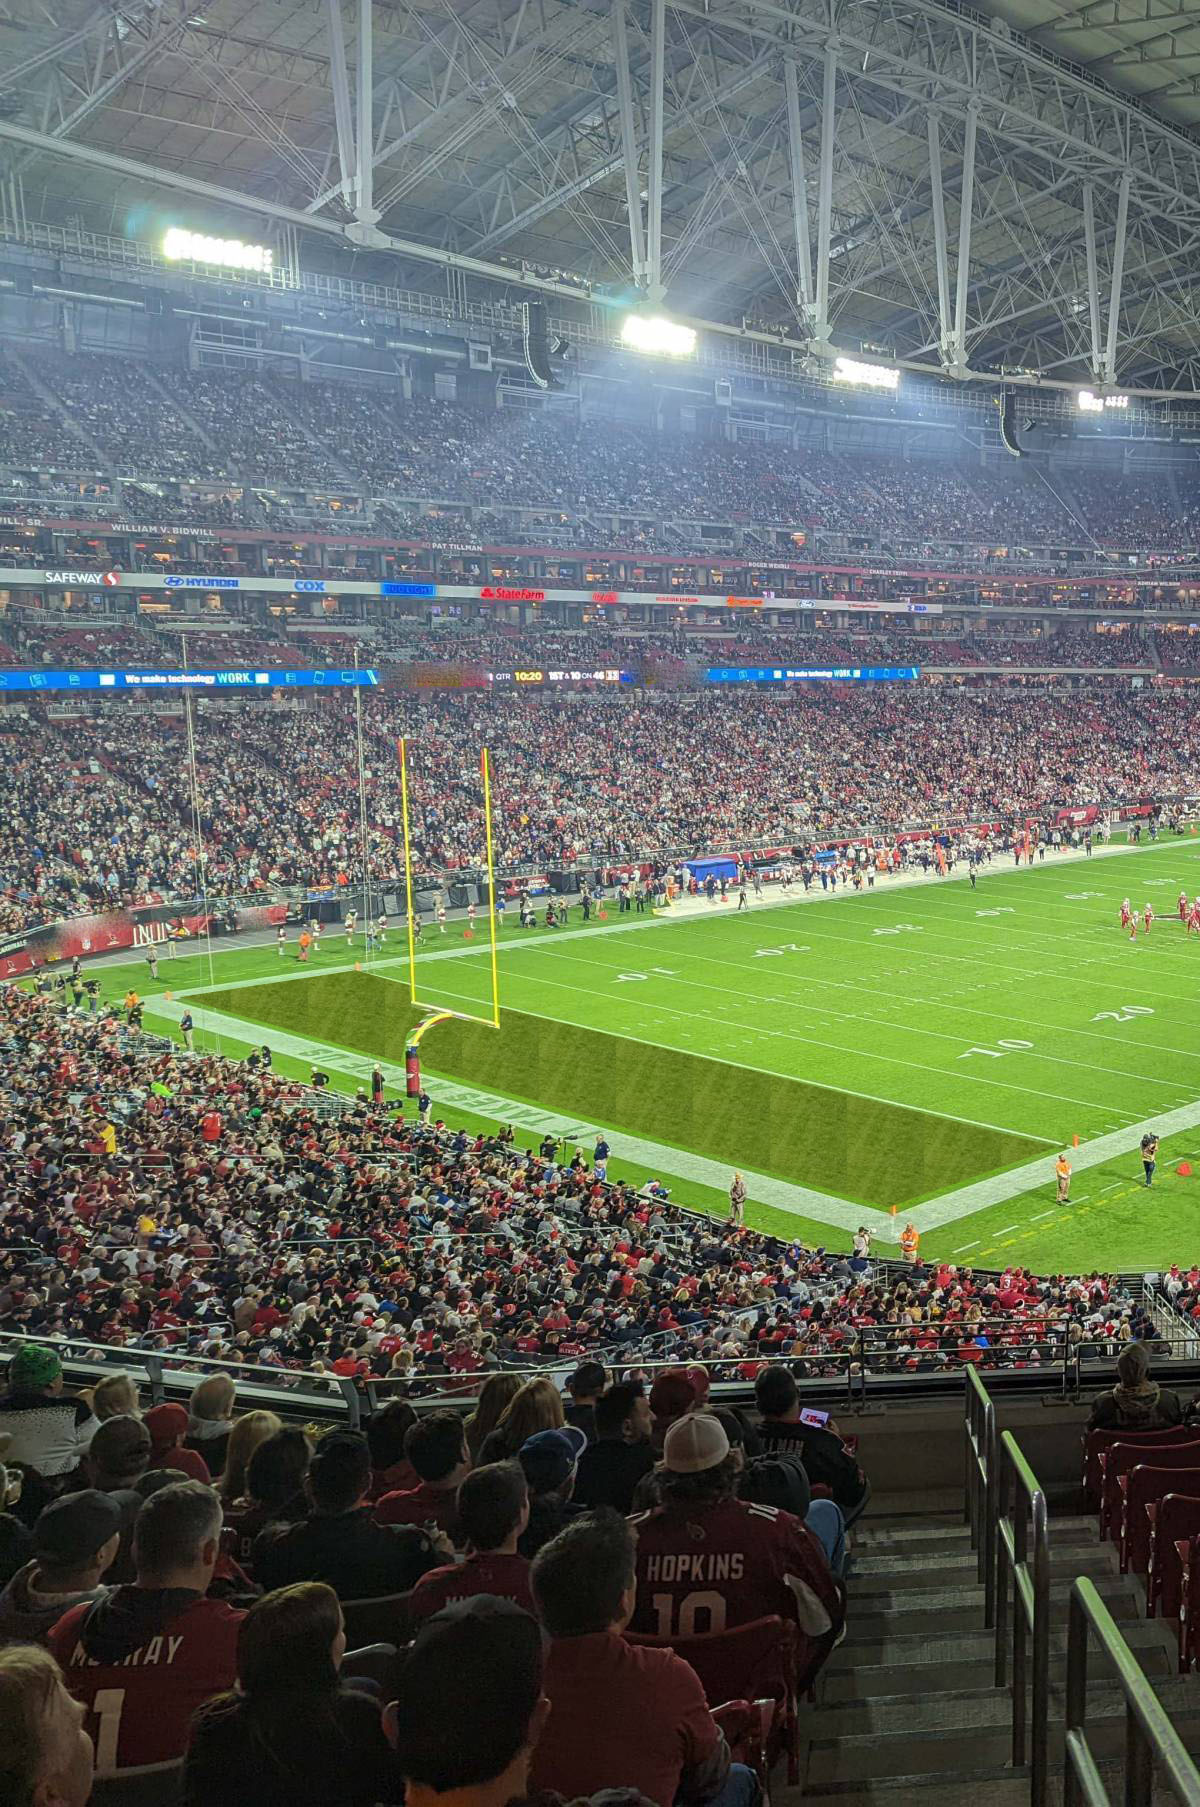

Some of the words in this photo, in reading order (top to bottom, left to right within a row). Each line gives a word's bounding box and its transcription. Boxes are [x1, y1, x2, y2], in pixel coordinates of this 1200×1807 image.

[27, 518, 45, 527] SR.
[111, 523, 157, 534] WILLIAM
[173, 527, 216, 537] BIDWILL
[432, 542, 448, 550] PAT
[449, 543, 483, 552] TILLMAN
[45, 572, 103, 583] SAFEWAY
[186, 578, 239, 588] HYUNDAI
[294, 580, 325, 592] COX
[125, 674, 140, 684] We
[141, 674, 167, 683] make
[168, 674, 216, 685] technology
[217, 672, 253, 684] WORK.
[514, 671, 543, 681] 10:20
[549, 671, 564, 681] 1ST
[570, 671, 582, 681] 10
[1096, 1005, 1155, 1022] 20
[963, 1039, 1034, 1058] 10
[1004, 1279, 1010, 1289] 3
[647, 1552, 744, 1583] HOPKINS
[652, 1590, 727, 1637] 10
[93, 1688, 125, 1773] 1
